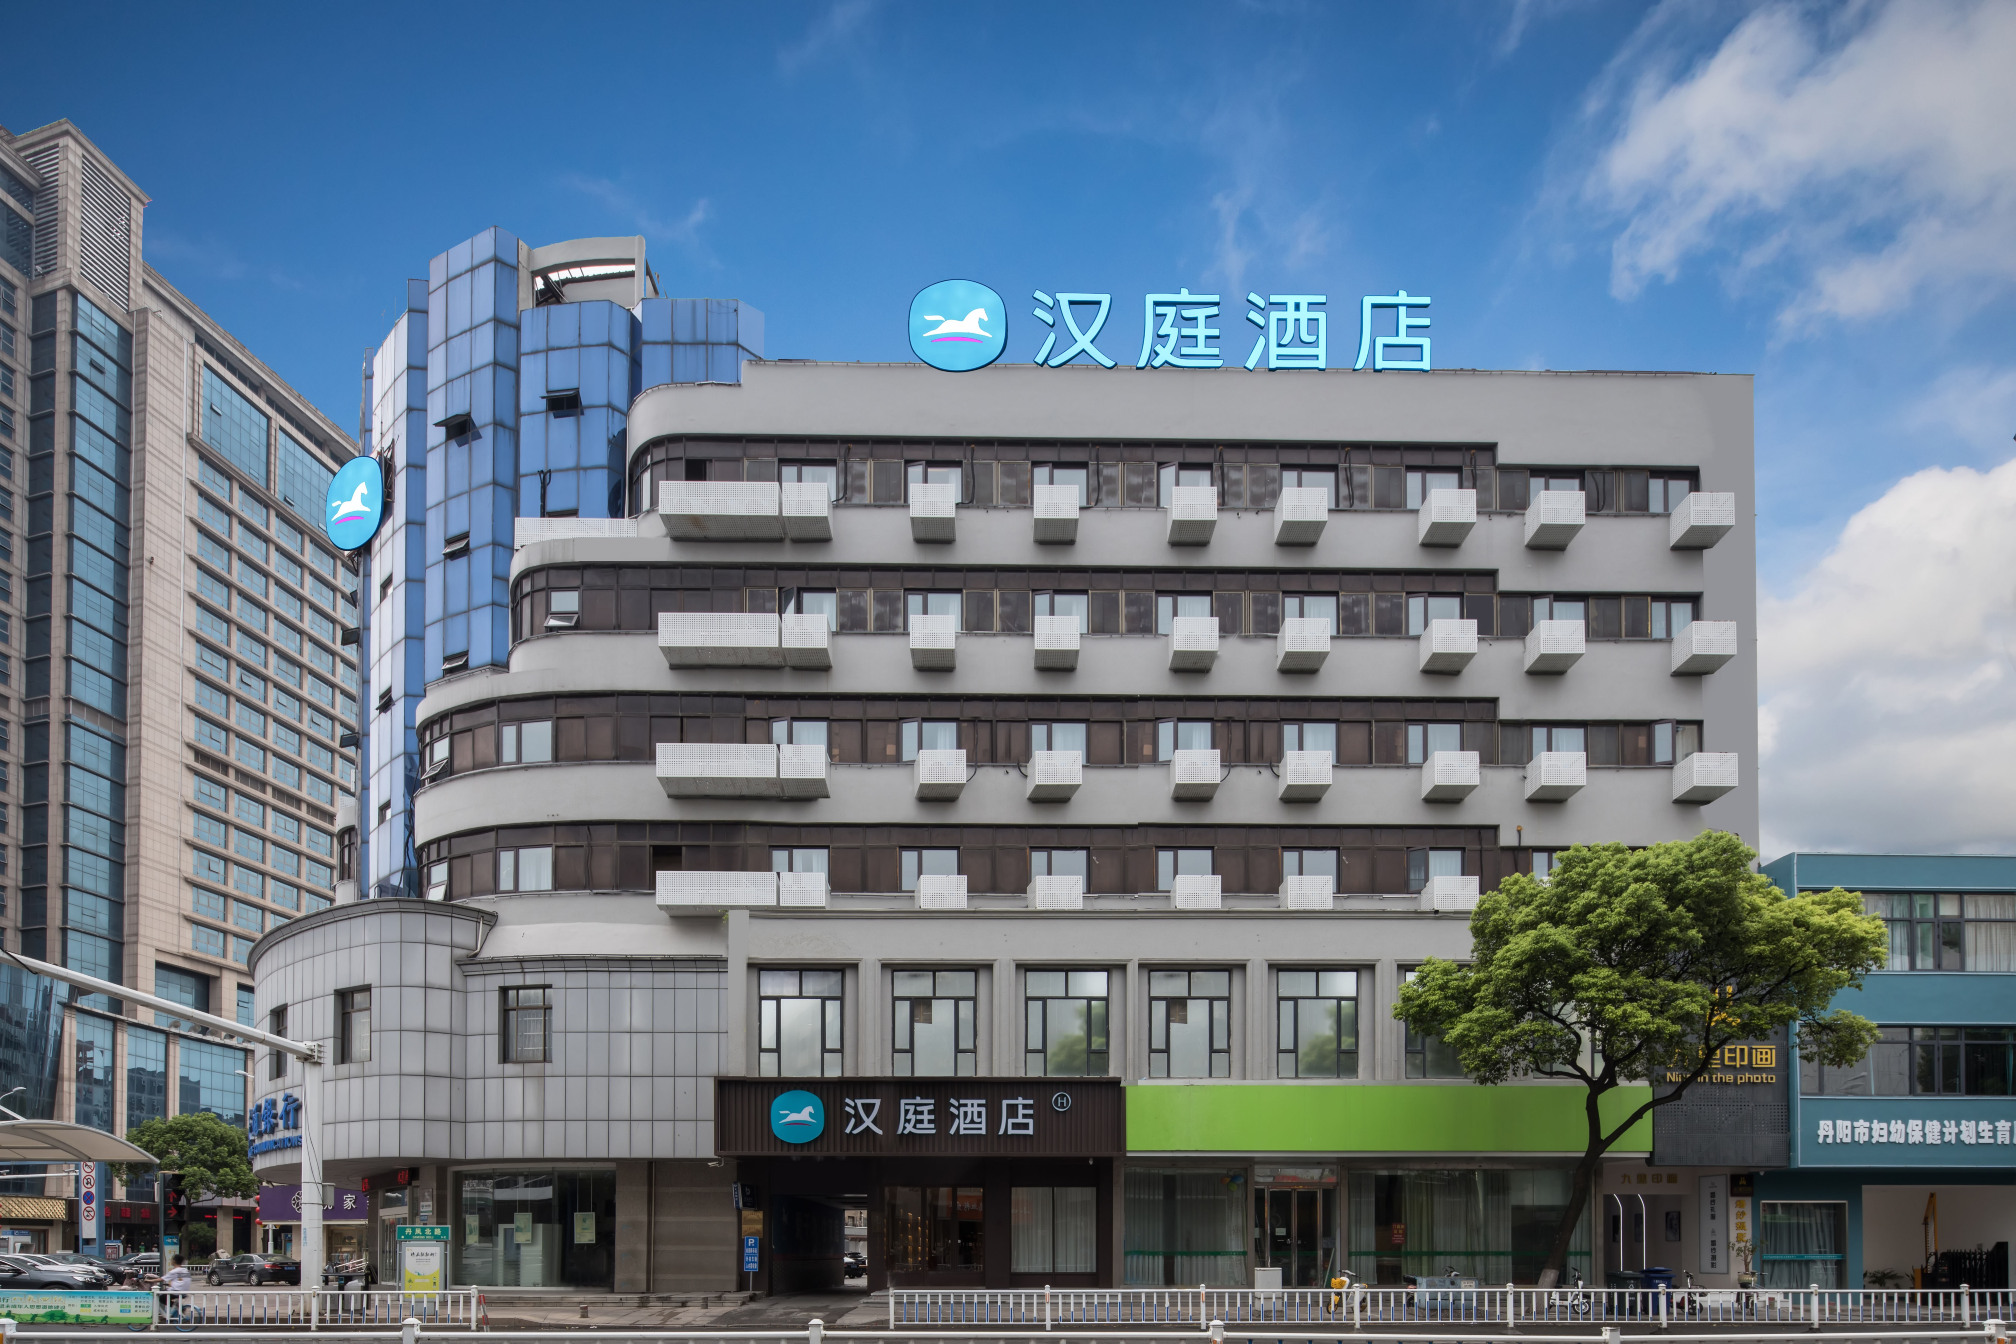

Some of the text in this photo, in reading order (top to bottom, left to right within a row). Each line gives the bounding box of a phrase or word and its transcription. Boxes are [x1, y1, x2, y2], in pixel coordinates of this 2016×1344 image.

[1032, 287, 1432, 372] 汉庭酒店
[1712, 1072, 1734, 1083] the
[1737, 1072, 1776, 1085] photo
[248, 1092, 302, 1137] 通银行
[844, 1095, 1035, 1135] 汉庭酒店
[1817, 1118, 2016, 1145] 丹阳市妇幼保健计划生育
